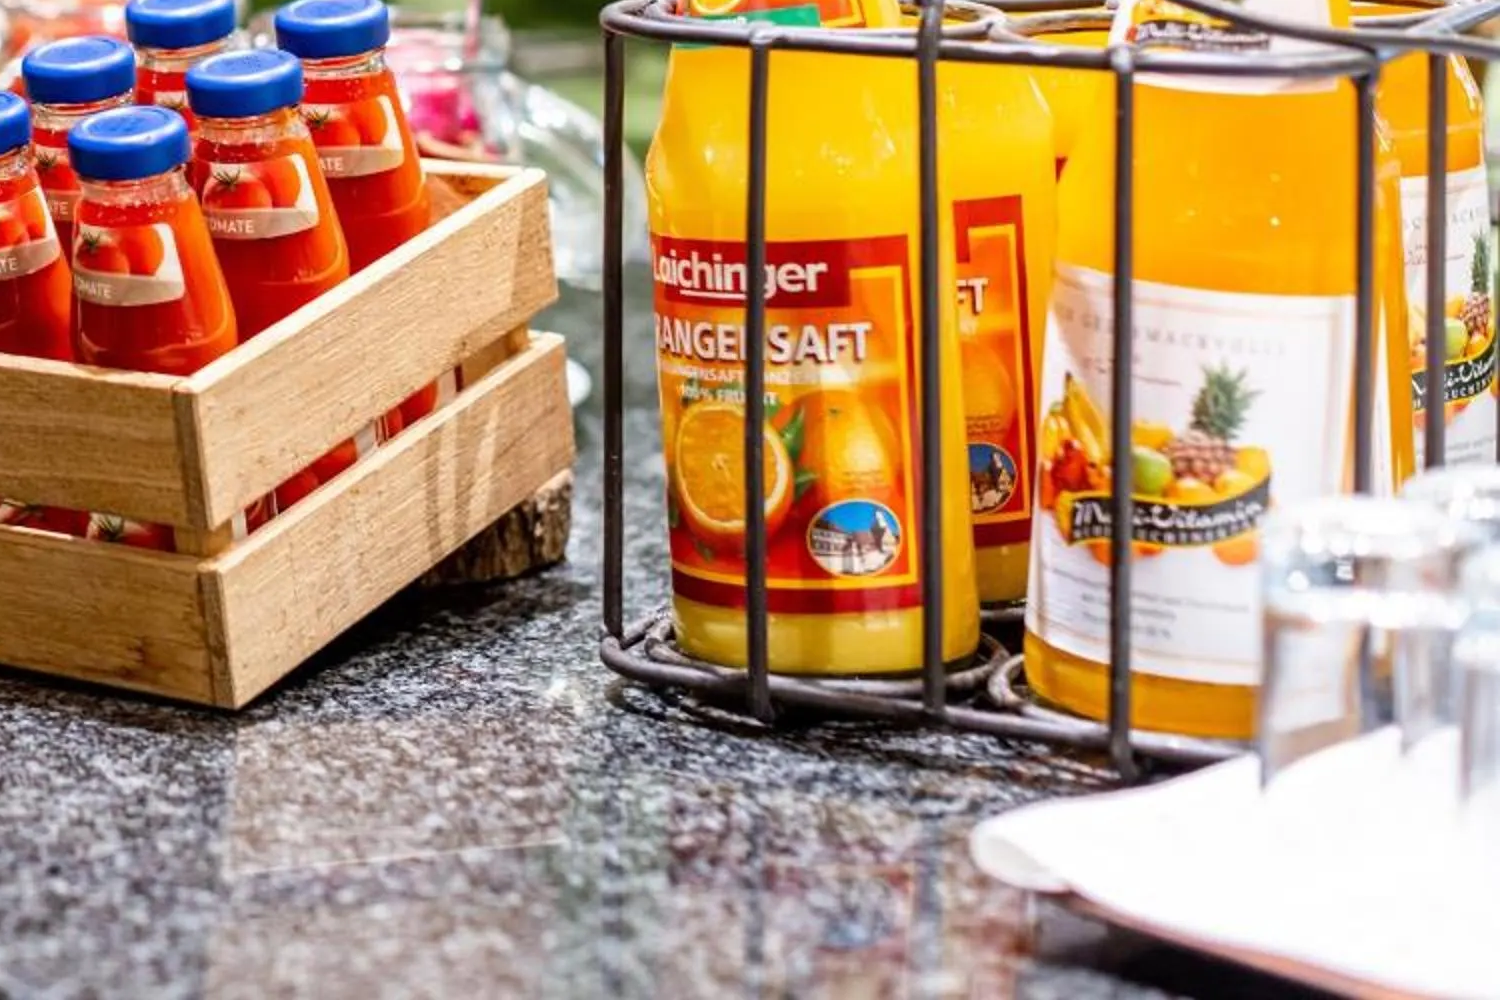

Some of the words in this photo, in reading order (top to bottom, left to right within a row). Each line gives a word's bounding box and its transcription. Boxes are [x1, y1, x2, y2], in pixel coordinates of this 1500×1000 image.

[318, 157, 344, 172] ATE
[210, 217, 255, 234] OMATE
[76, 274, 112, 298] OMATE
[656, 312, 873, 364] ANGESAFT
